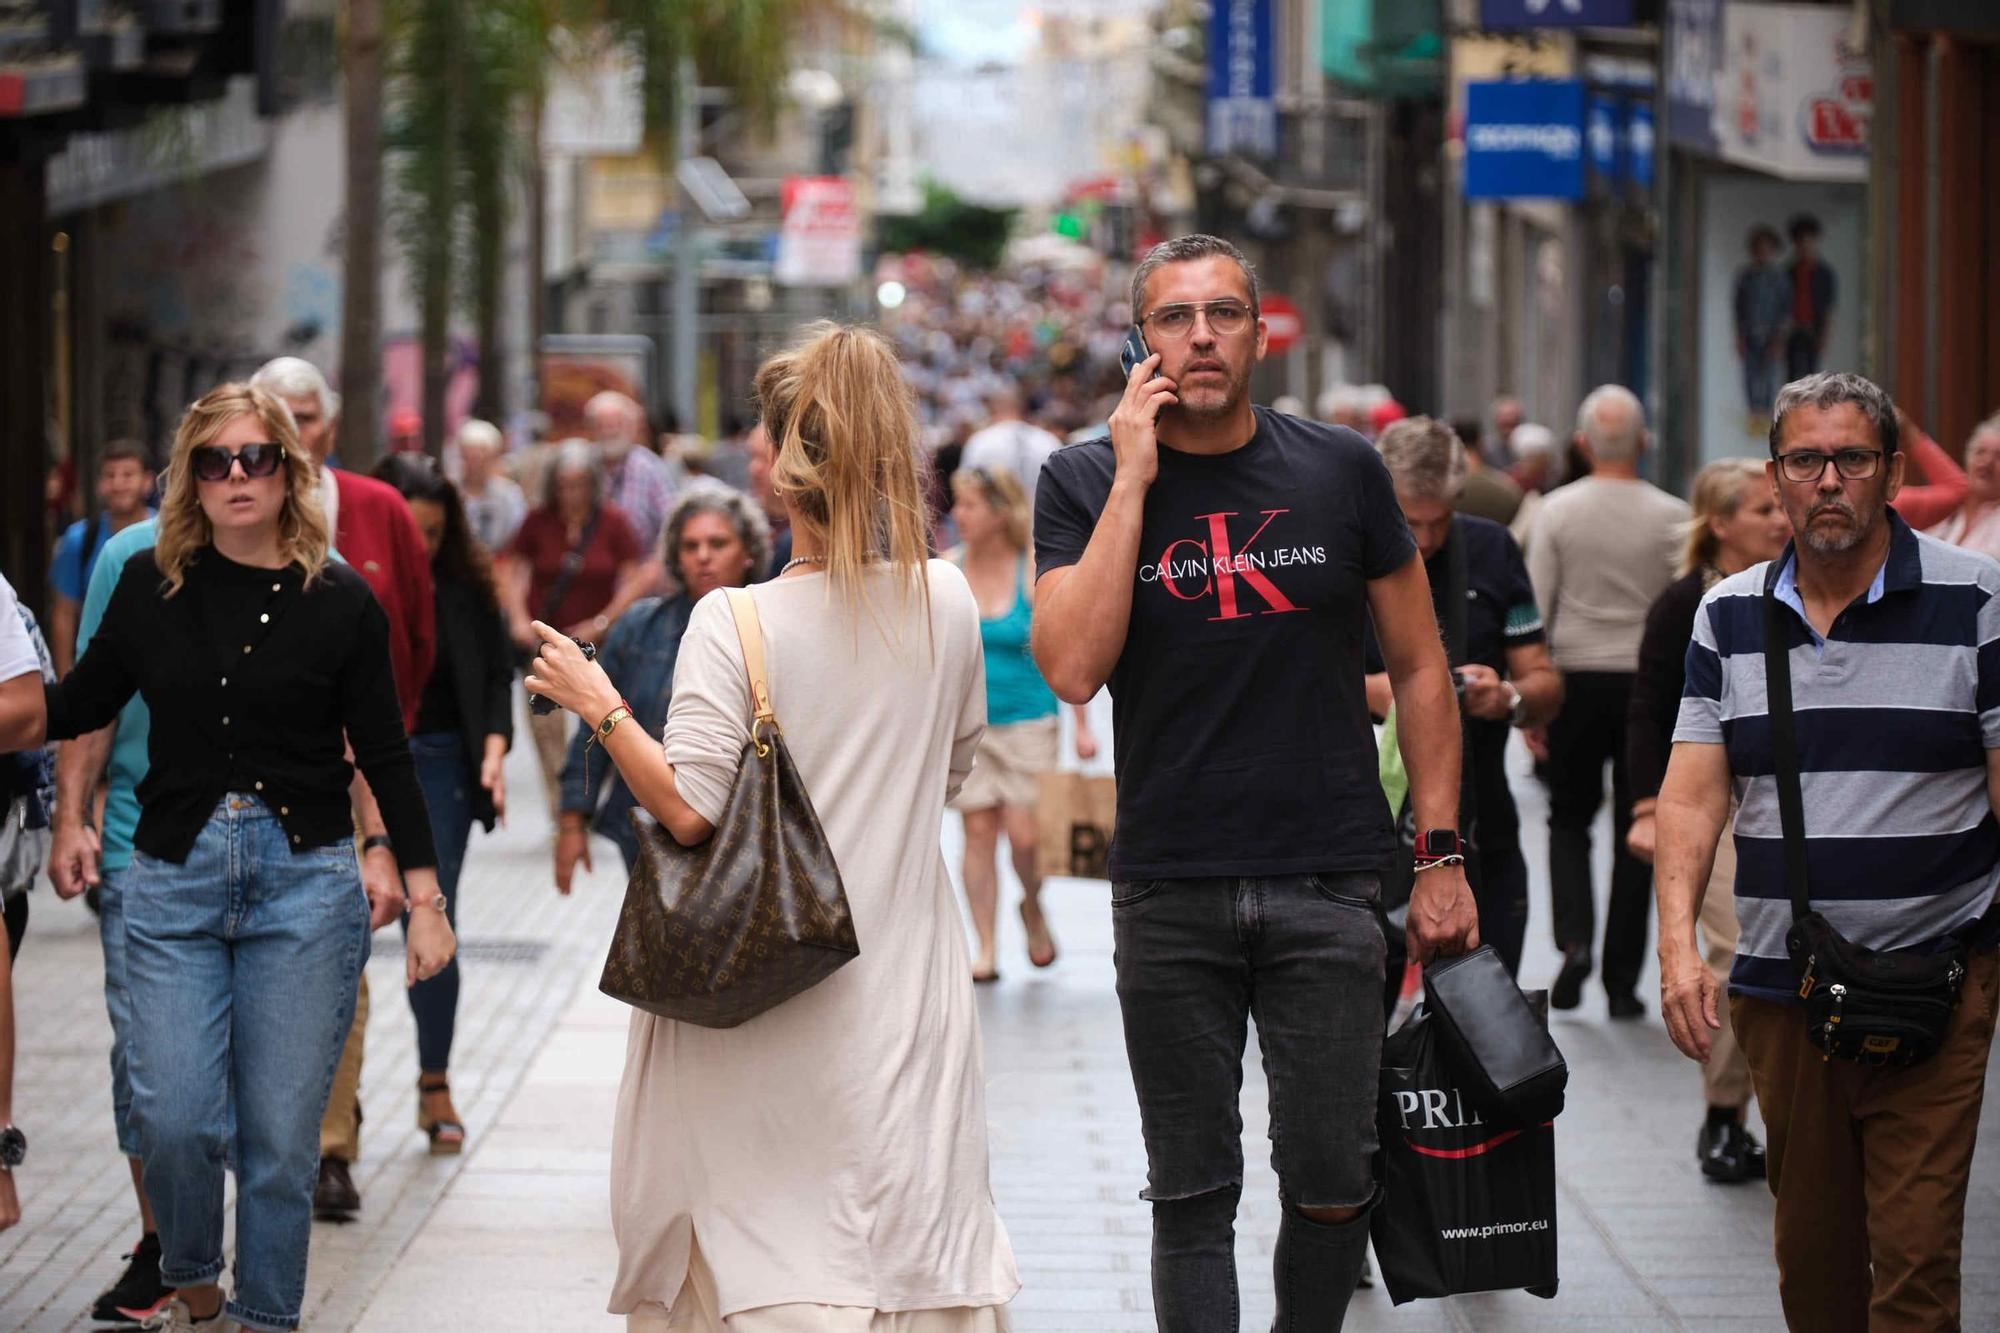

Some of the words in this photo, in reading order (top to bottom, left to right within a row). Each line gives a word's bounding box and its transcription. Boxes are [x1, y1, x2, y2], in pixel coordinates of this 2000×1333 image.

[1139, 558, 1208, 582] CALVIN
[1212, 552, 1265, 575] KLEIN
[1269, 546, 1327, 568] JEANS
[1441, 1219, 1549, 1240] www.primor.eu
